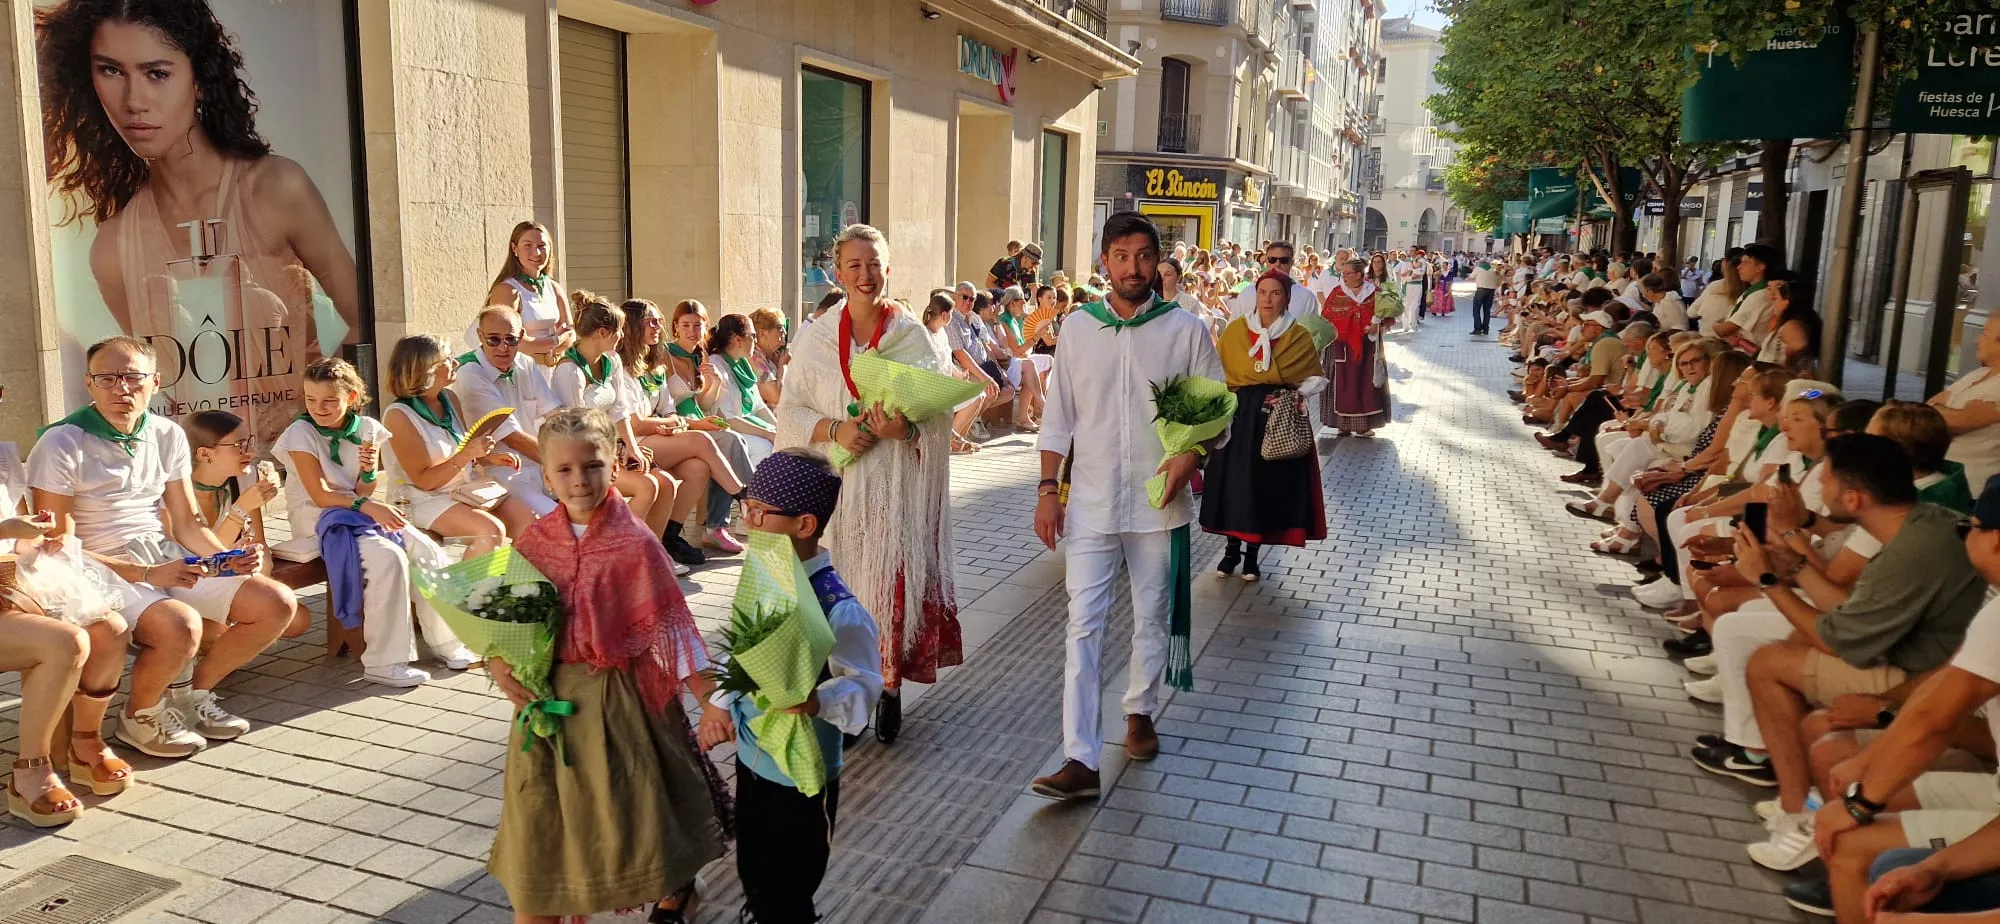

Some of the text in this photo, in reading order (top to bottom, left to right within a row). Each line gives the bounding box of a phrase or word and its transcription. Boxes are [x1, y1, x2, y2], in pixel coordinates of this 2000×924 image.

[1944, 14, 1996, 35] an
[1918, 91, 1983, 103] fiestas de
[1929, 105, 1980, 118] Huesca
[1146, 168, 1164, 197] El
[1165, 169, 1218, 199] Rincón
[139, 313, 293, 389] DÔLE
[149, 389, 294, 417] NUEVO PERFUME
